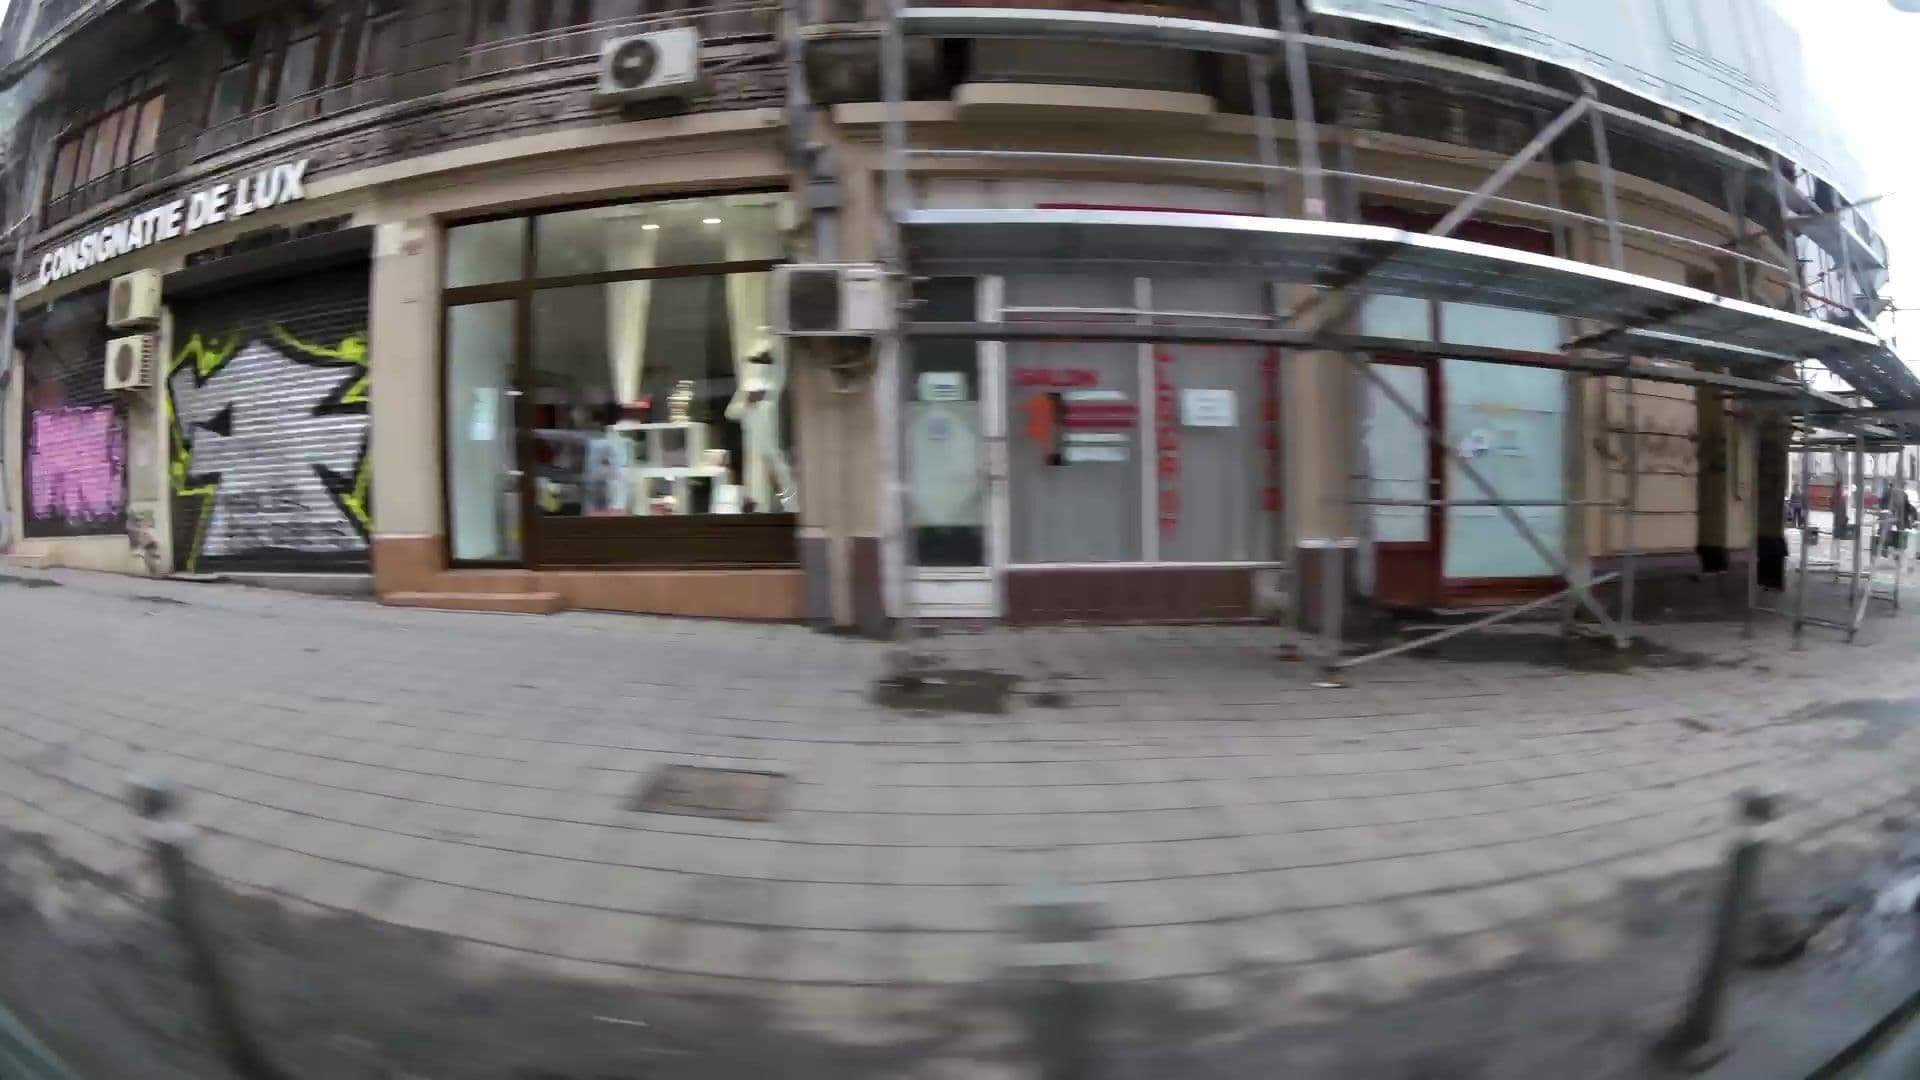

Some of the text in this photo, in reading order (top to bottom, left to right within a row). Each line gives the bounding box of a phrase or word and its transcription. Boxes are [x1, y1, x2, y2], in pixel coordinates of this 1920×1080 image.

[38, 159, 308, 285] CONSIGNATIE DE LUX
